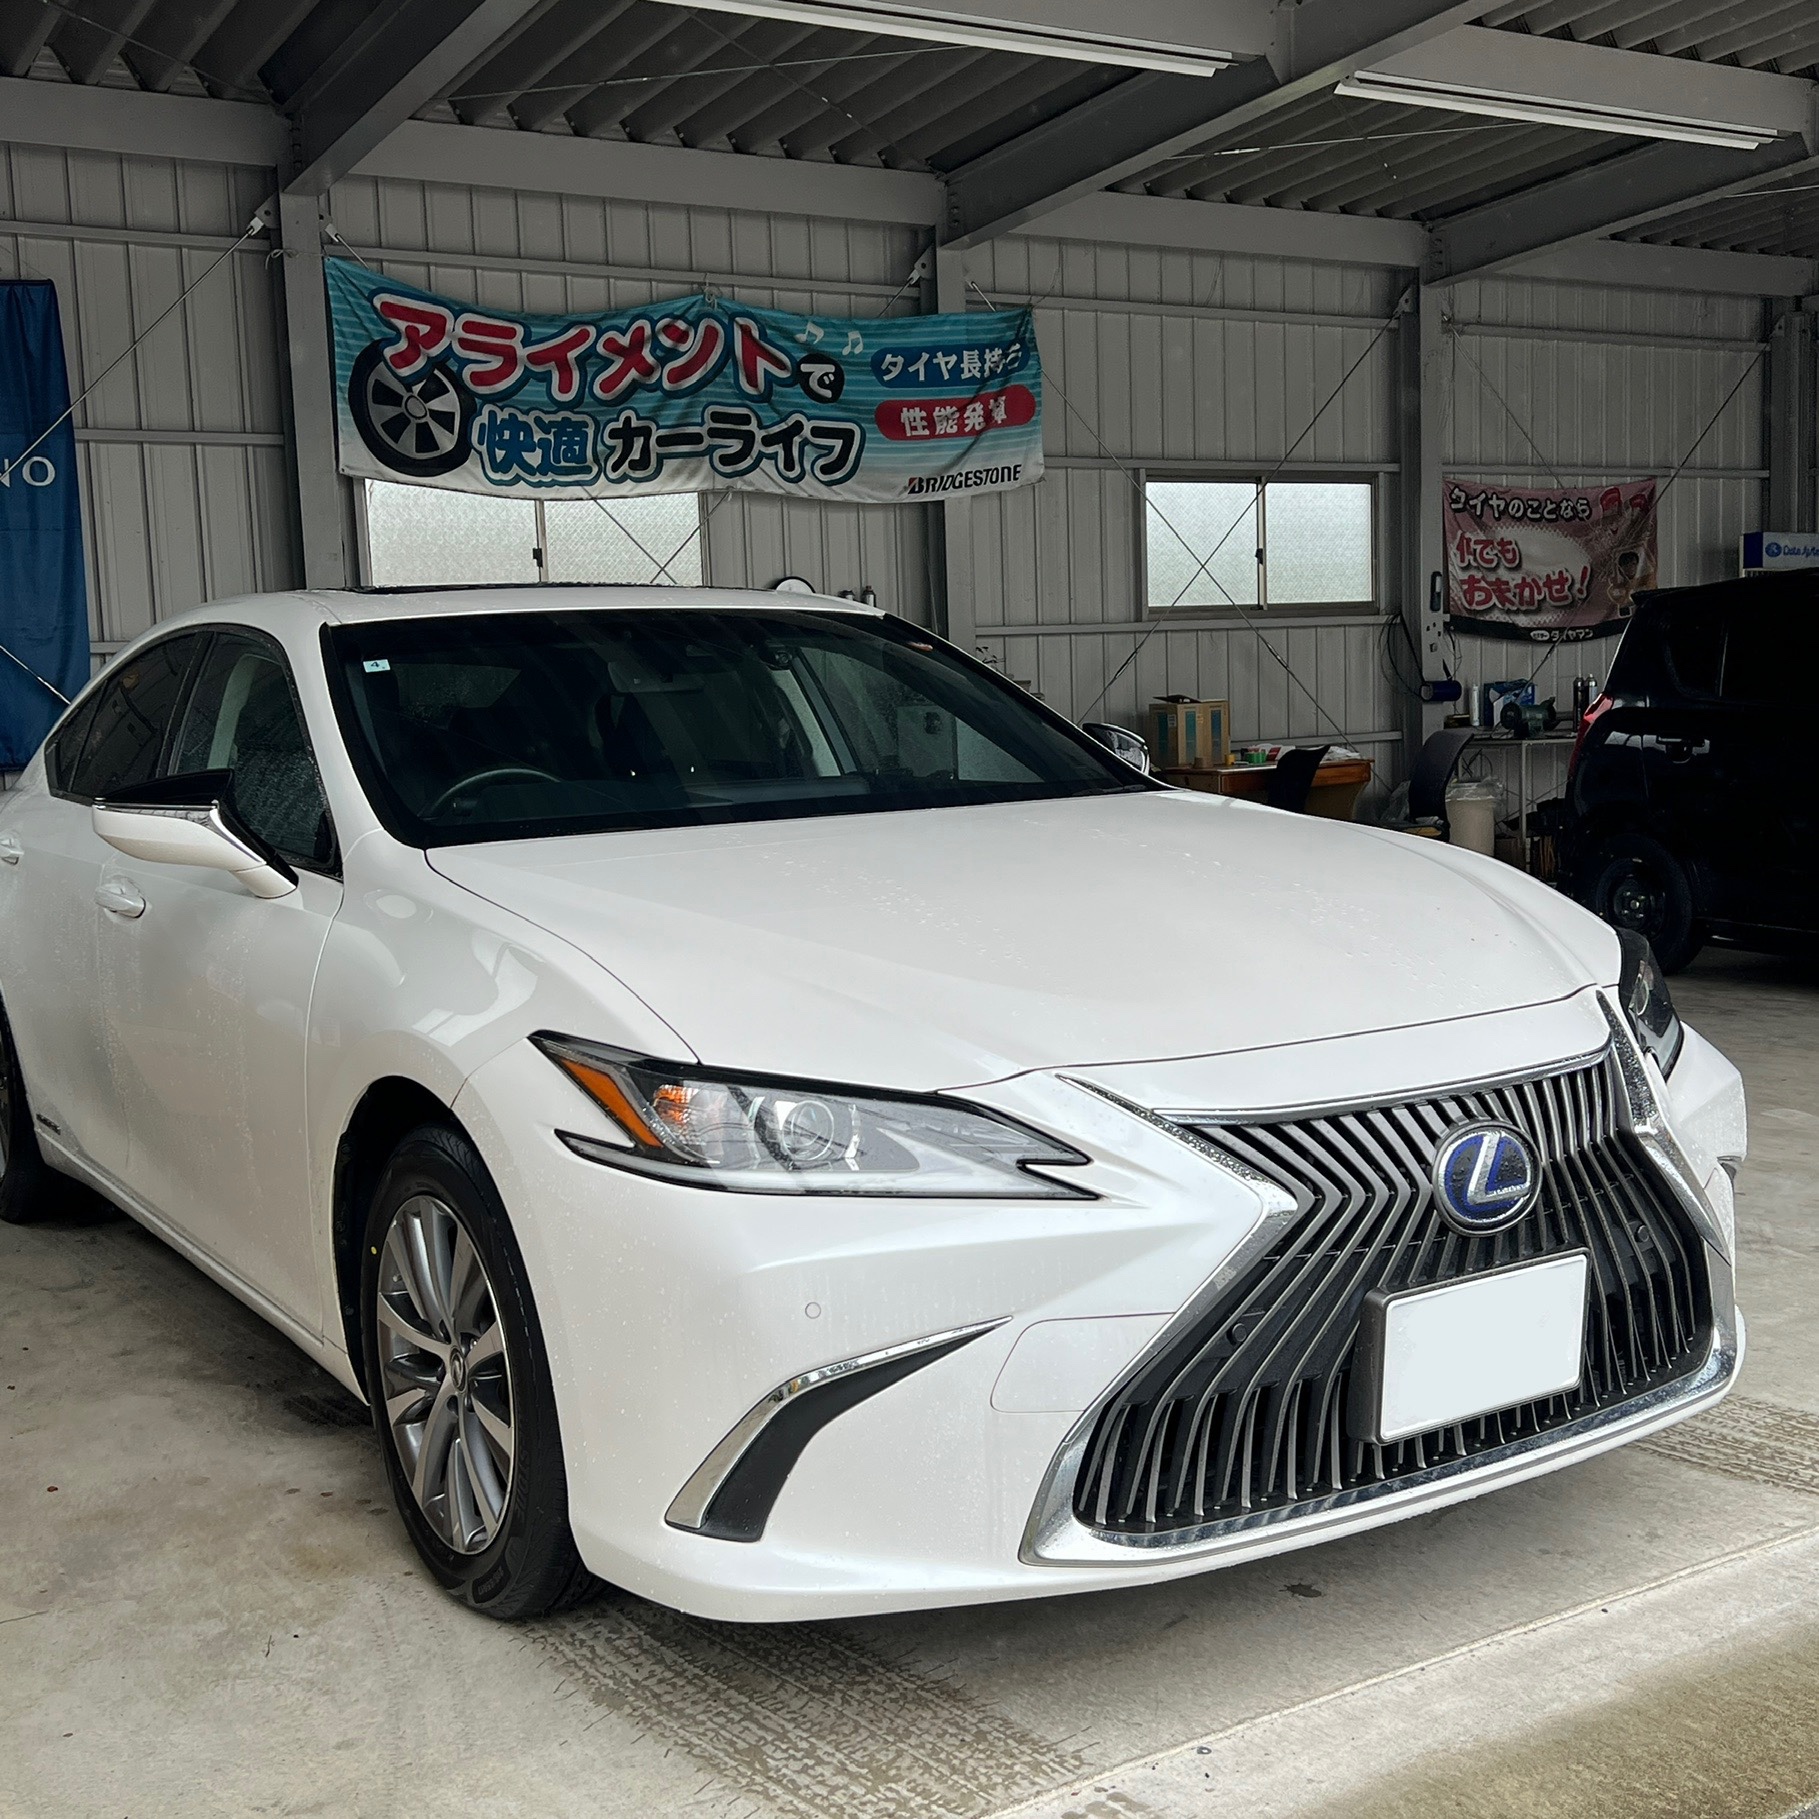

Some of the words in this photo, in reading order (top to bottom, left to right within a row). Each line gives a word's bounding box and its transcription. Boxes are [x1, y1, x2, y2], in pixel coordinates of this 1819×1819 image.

[375, 294, 838, 401] アライメントで
[908, 464, 1022, 495] BRIDGESTONE
